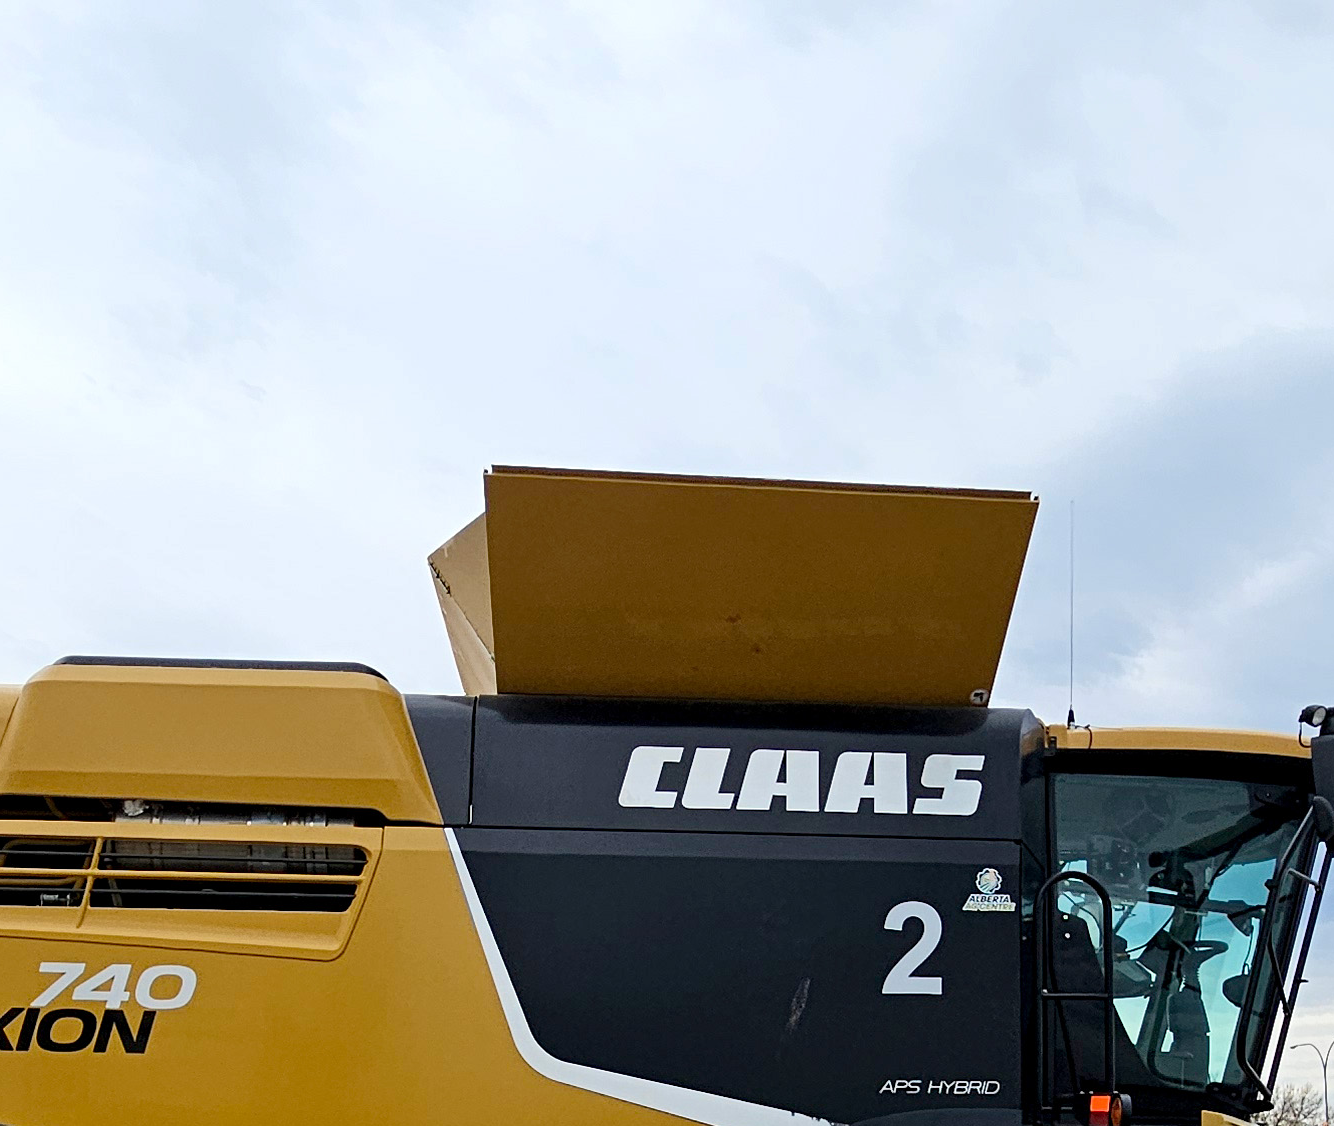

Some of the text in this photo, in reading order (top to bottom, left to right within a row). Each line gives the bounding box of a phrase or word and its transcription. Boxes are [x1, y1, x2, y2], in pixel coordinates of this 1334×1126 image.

[618, 745, 985, 816] CLAAS
[969, 895, 1009, 903] ALBERTA
[881, 901, 943, 995] 2
[30, 962, 197, 1010] 740
[879, 1080, 1000, 1095] APS HYBRID
